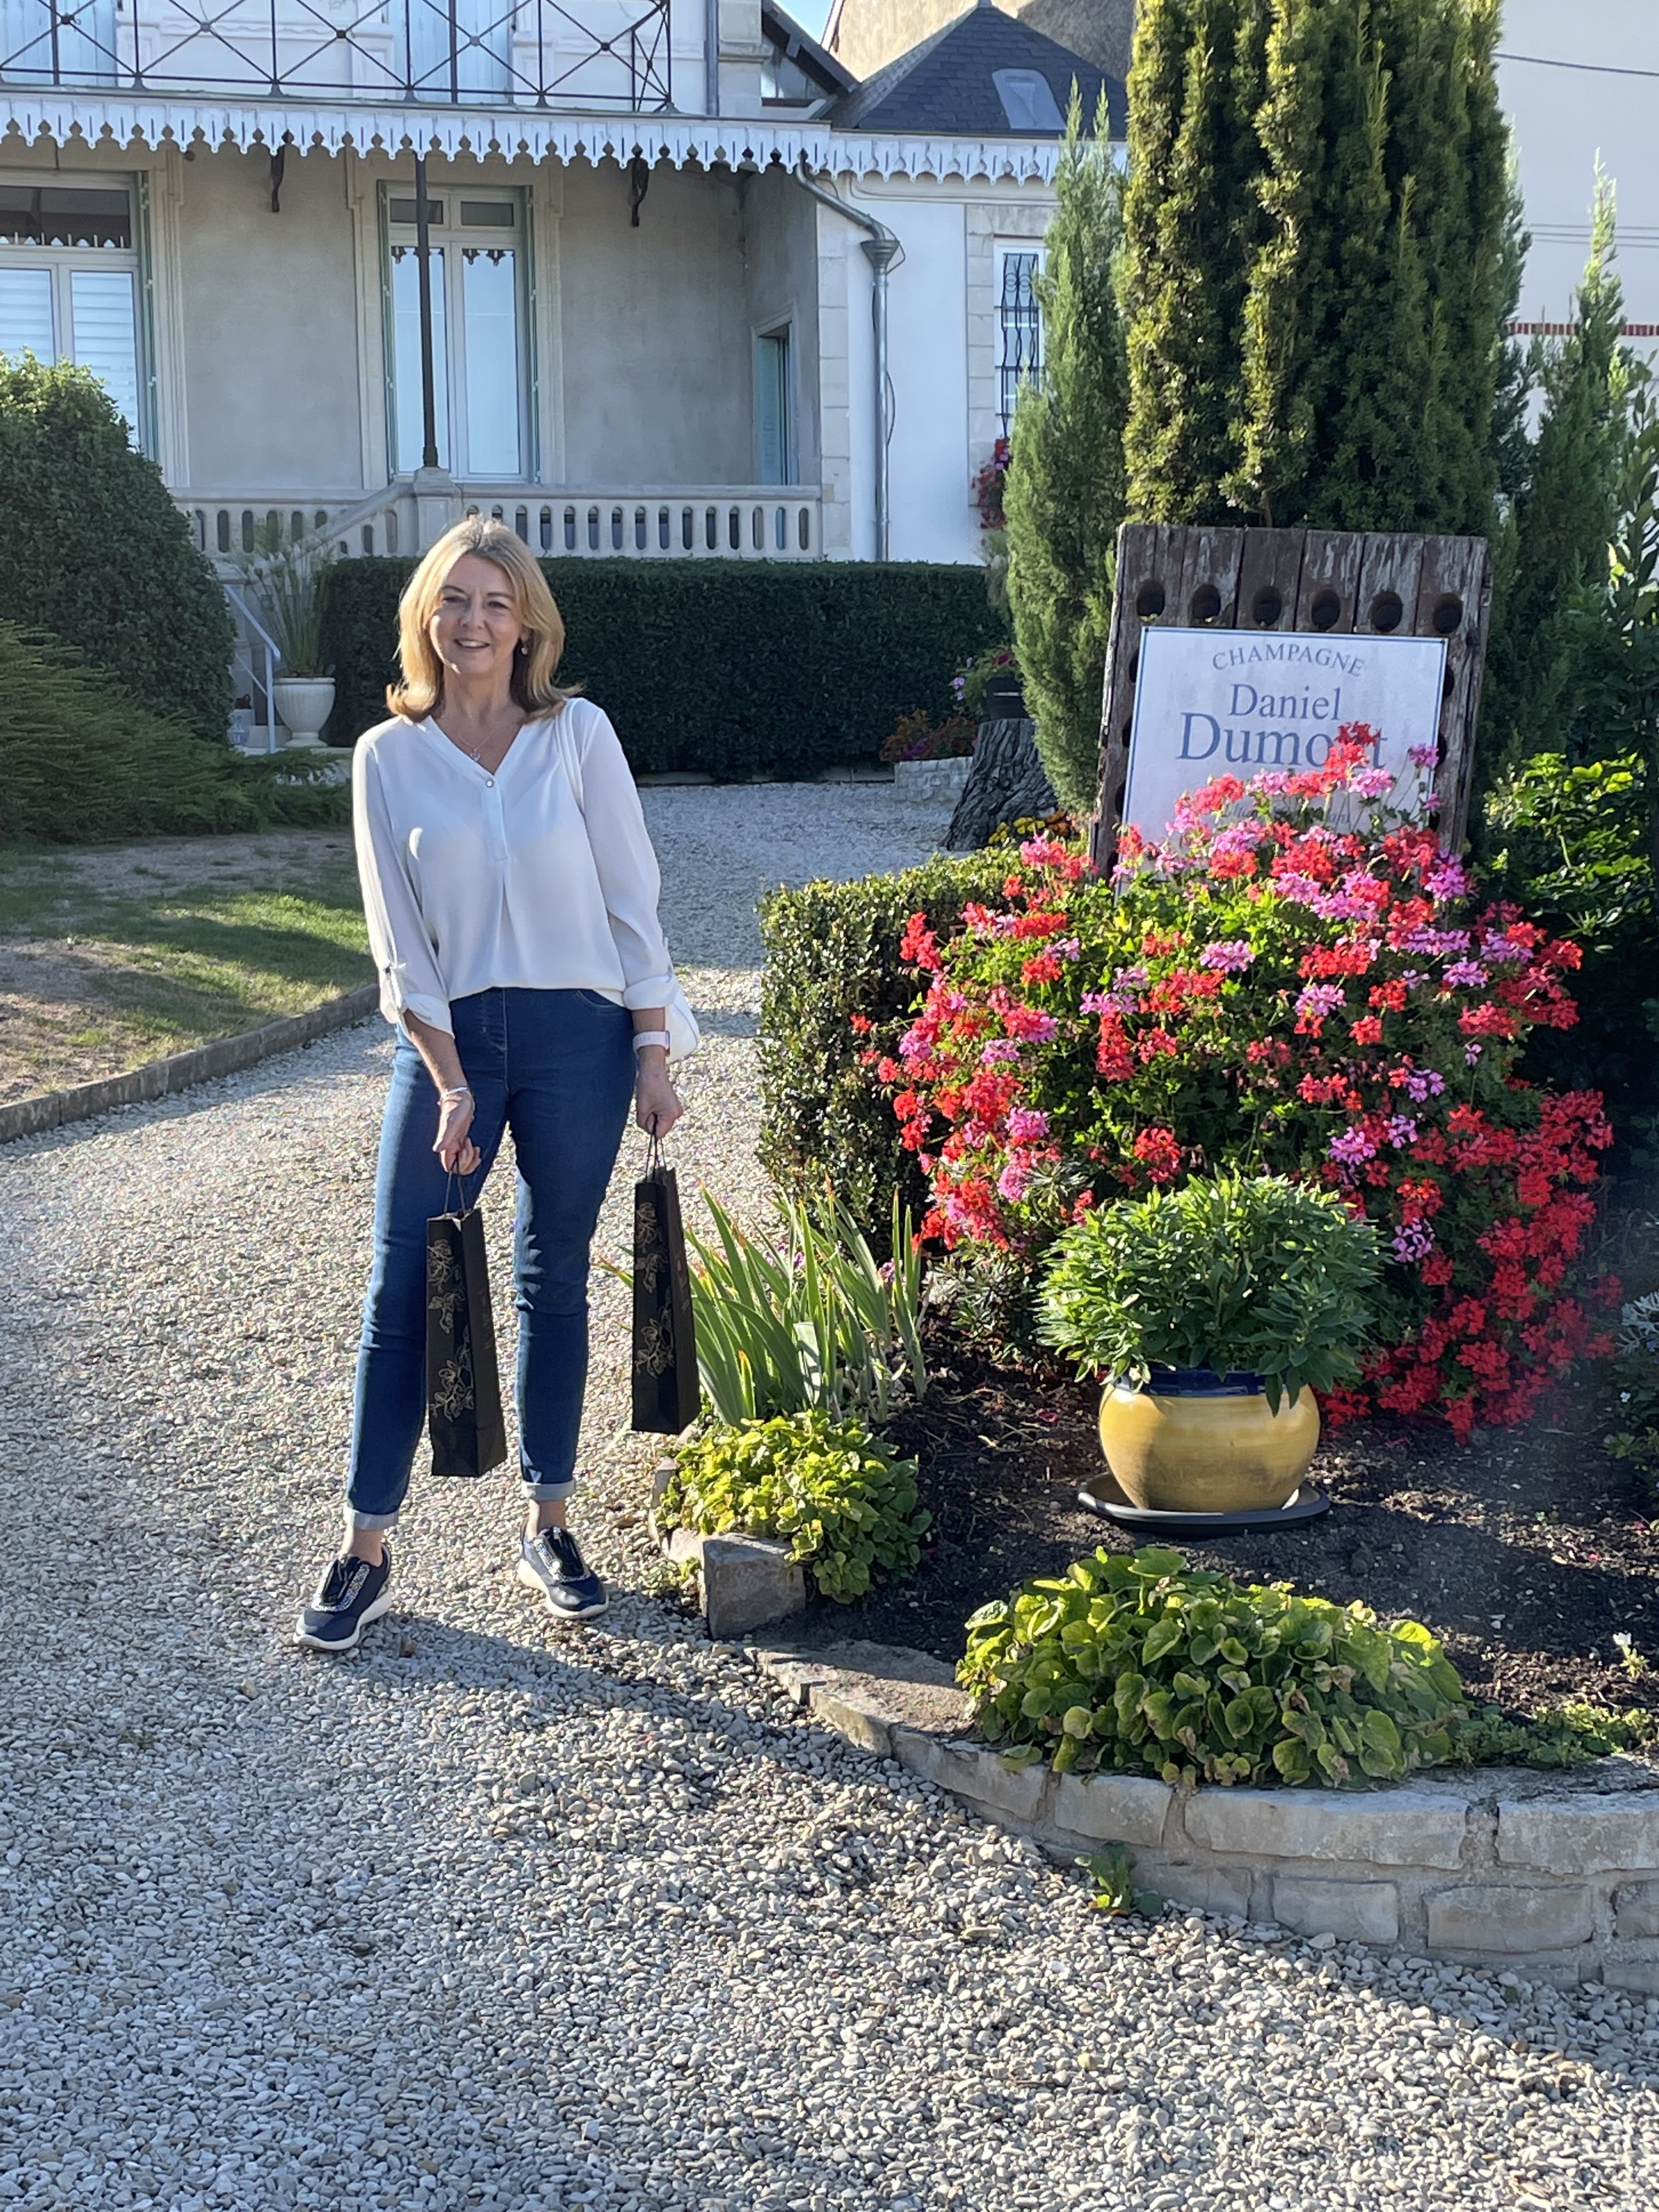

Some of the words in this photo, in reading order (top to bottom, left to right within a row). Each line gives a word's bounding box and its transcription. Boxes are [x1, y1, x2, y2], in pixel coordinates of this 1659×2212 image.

[1212, 643, 1365, 677] CHAMPAGNE
[1228, 684, 1341, 720] Daniel
[1176, 712, 1388, 769] Dumot
